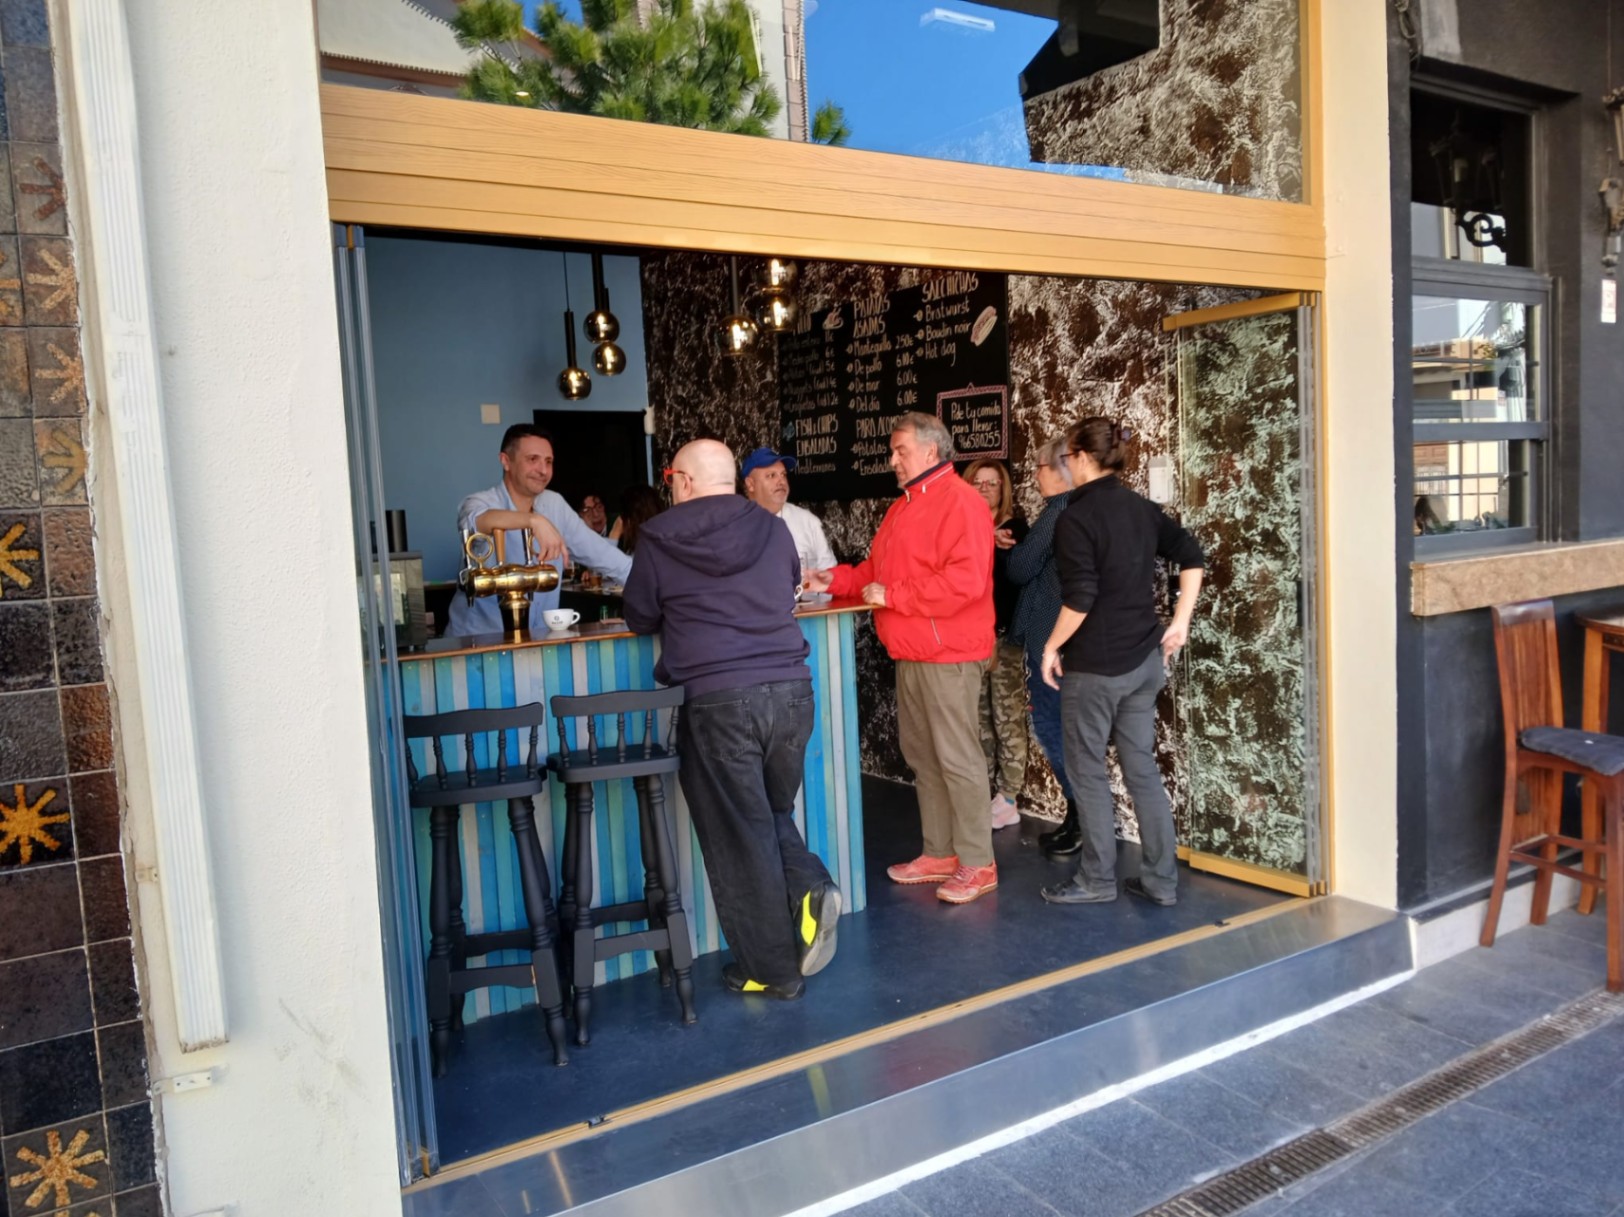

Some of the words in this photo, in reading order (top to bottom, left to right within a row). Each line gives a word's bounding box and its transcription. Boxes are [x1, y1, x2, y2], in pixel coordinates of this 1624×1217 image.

[921, 272, 979, 303] SALCHICHAS
[853, 293, 891, 320] PATATAS
[925, 295, 970, 323] Bratwurst
[853, 314, 886, 339] ASADAS
[925, 322, 952, 342] Boudin
[954, 320, 972, 334] noir
[925, 342, 938, 360] Hot
[940, 339, 957, 368] dog
[854, 358, 865, 376] De
[855, 377, 865, 394] De
[856, 394, 868, 413] Del
[951, 402, 964, 421] Pide
[976, 400, 1002, 418] comida
[796, 417, 812, 438] FISH
[817, 413, 839, 435] CHIPS
[856, 416, 876, 439] PARA
[857, 439, 888, 458] Patatas
